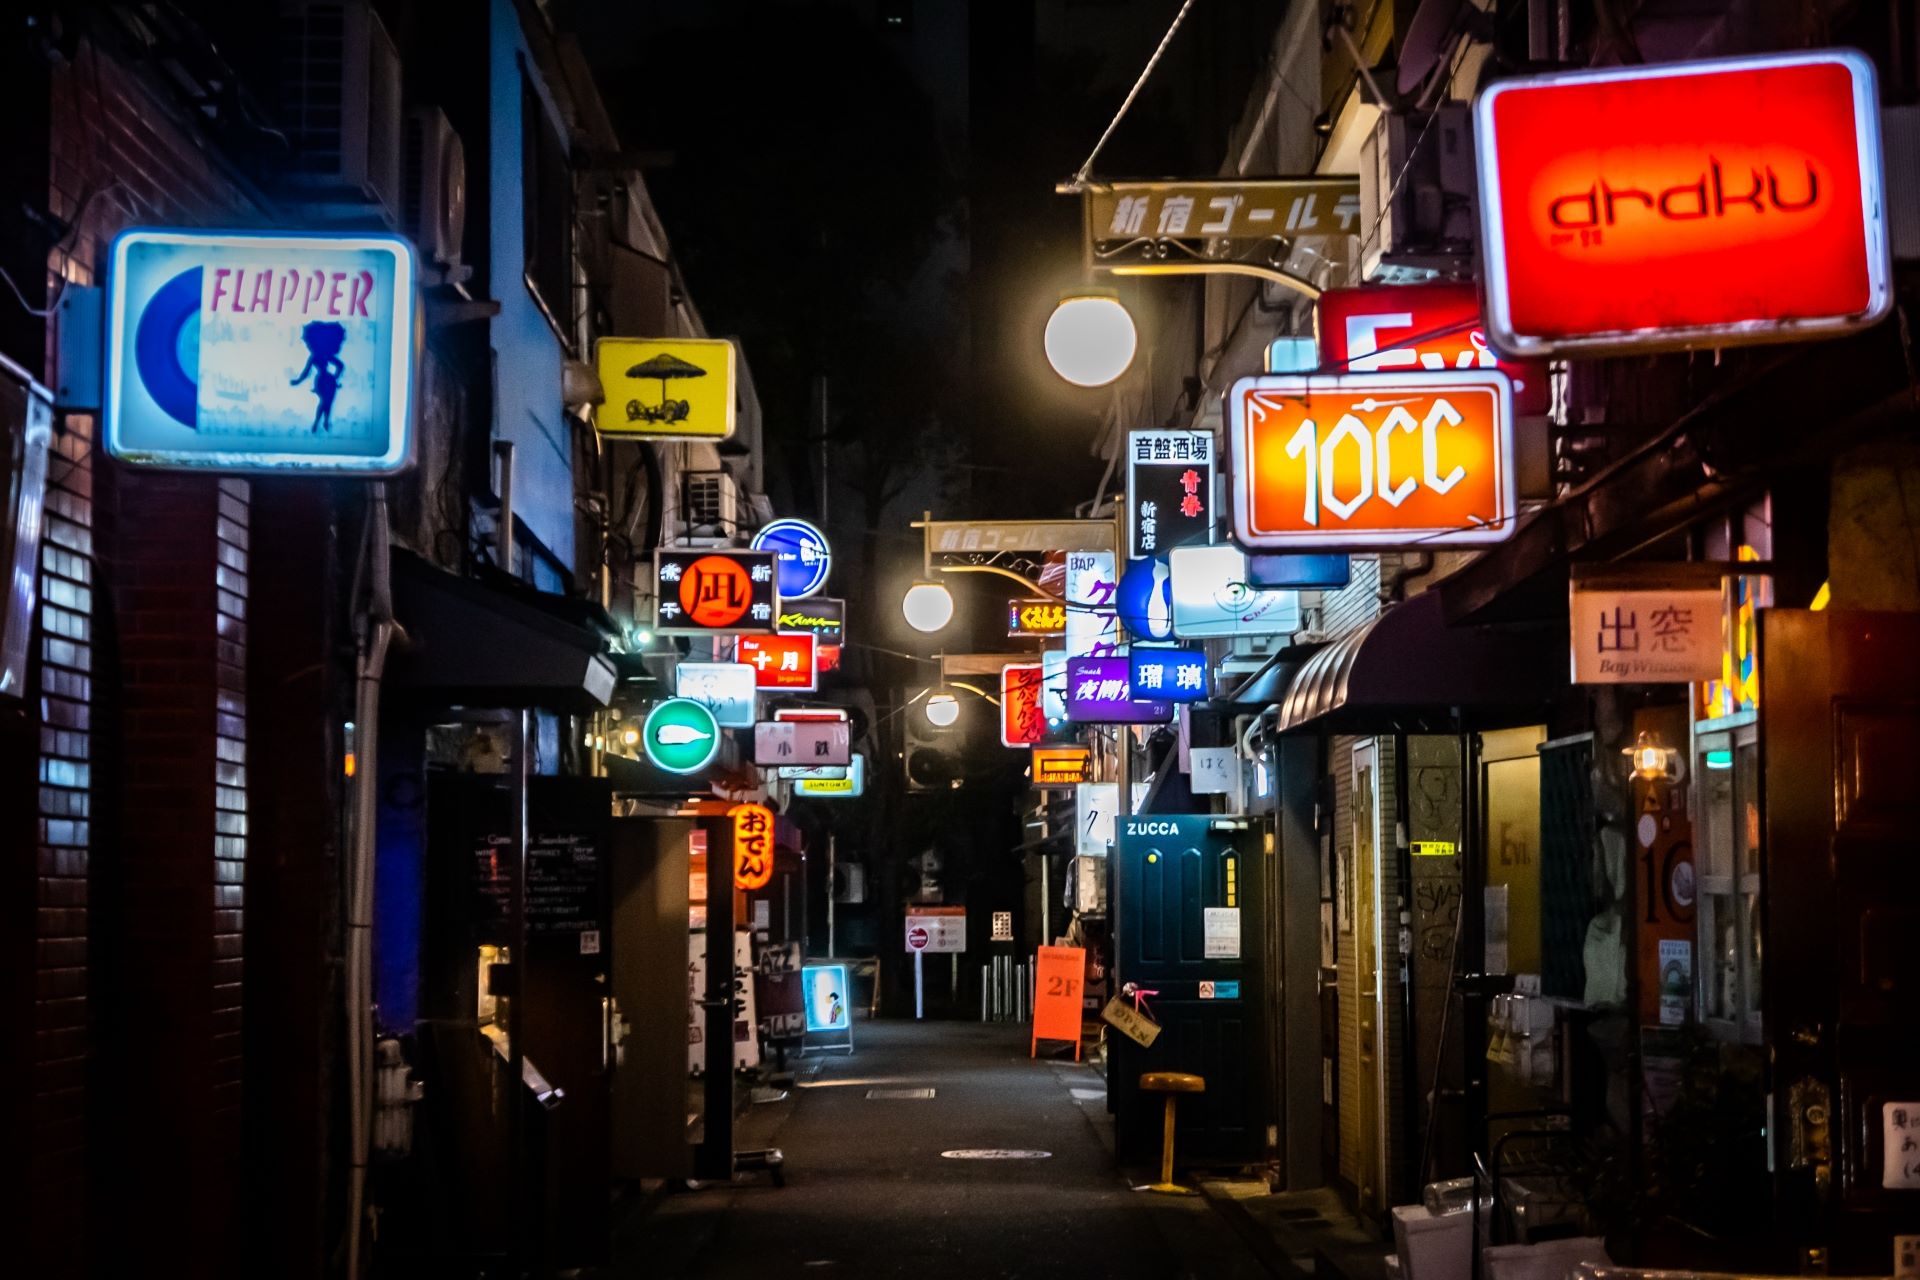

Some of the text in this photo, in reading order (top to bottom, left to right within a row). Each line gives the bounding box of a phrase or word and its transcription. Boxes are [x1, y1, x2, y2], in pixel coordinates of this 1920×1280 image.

[1548, 154, 1819, 228] araku
[210, 268, 375, 318] FLAPPER
[1135, 436, 1208, 461] 音盤酒場
[1140, 500, 1158, 550] 新宿店
[1070, 557, 1095, 571] BAR
[689, 564, 746, 617] 凪
[751, 564, 772, 620] 新宿
[1598, 605, 1696, 653] 出窓
[751, 650, 799, 672] 十月
[1075, 666, 1102, 676] Snack
[1599, 659, 1630, 676] Bay
[1138, 663, 1202, 690] 瑠璃
[1075, 679, 1130, 702] 夜間
[1127, 822, 1180, 836] ZUCCA
[739, 812, 766, 877] おでん
[1047, 976, 1080, 998] 2F
[1115, 1006, 1150, 1043] OPEN
